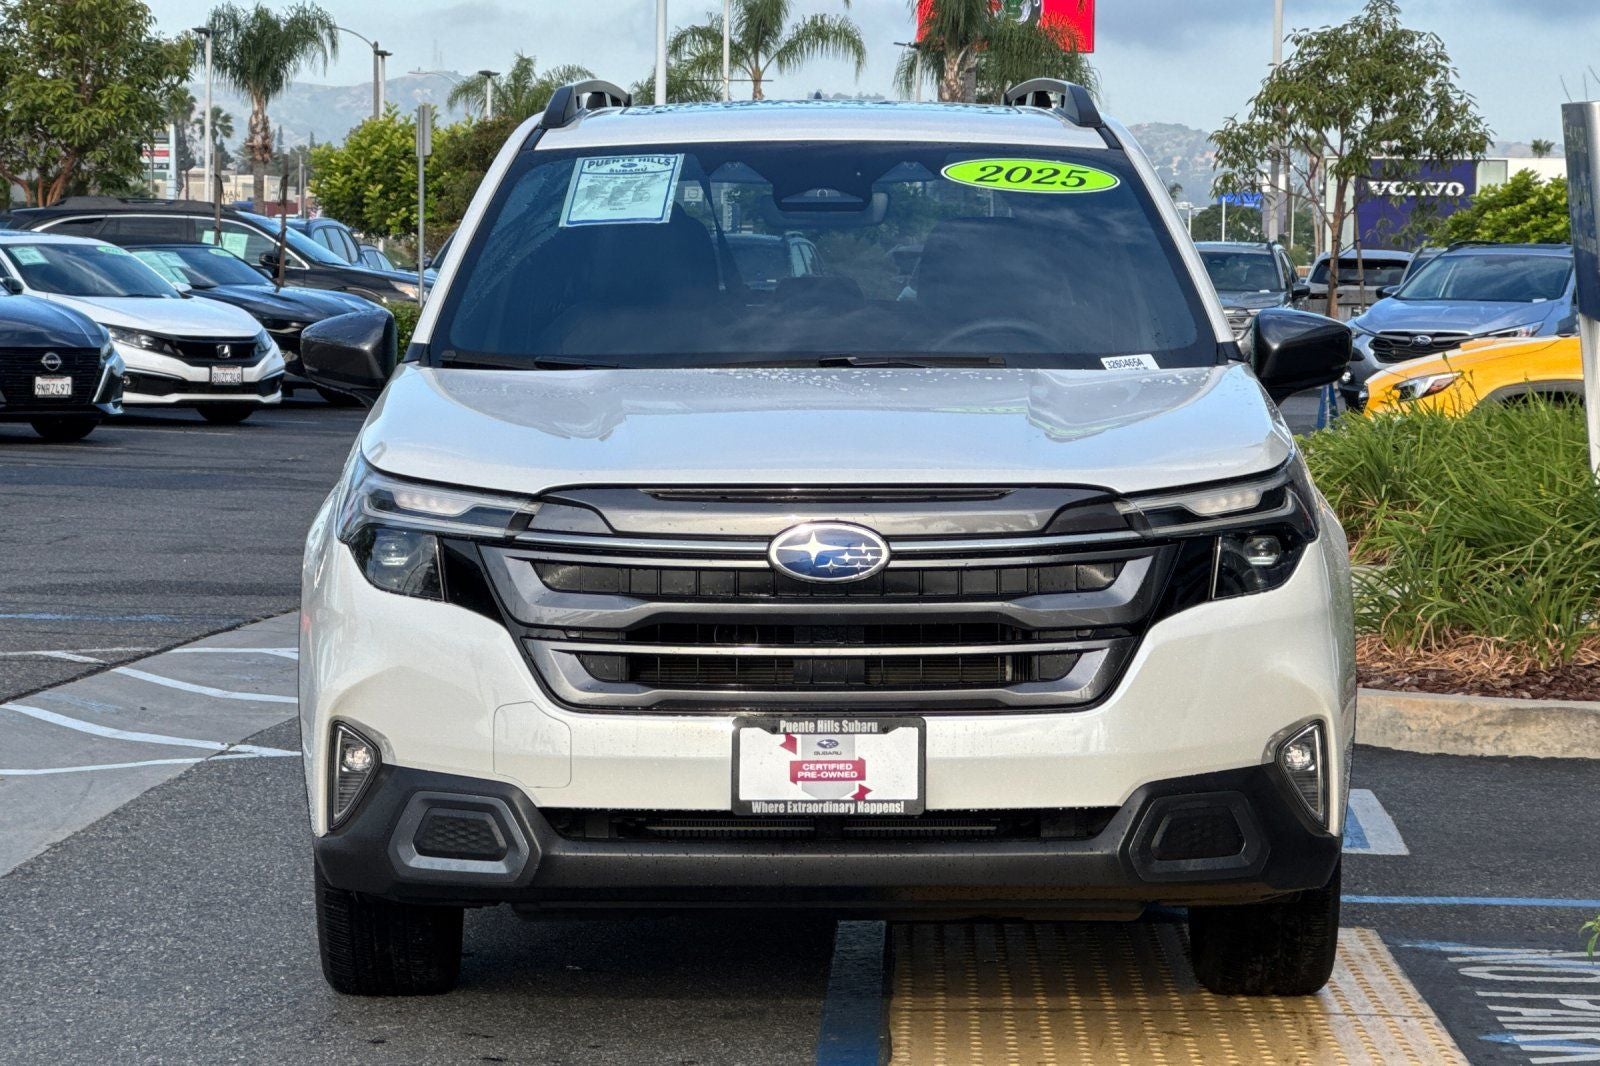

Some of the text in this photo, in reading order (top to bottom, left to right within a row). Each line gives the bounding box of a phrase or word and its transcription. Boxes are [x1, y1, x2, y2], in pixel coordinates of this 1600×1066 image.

[587, 157, 671, 168] PUENTE HILLS
[974, 165, 1090, 187] 2025
[780, 720, 878, 733] Puente Hills Subaru
[802, 763, 853, 771] CERTIFIED
[797, 771, 858, 779] PRE-OWNED
[752, 801, 905, 815] Where Extraordinary Happens!
